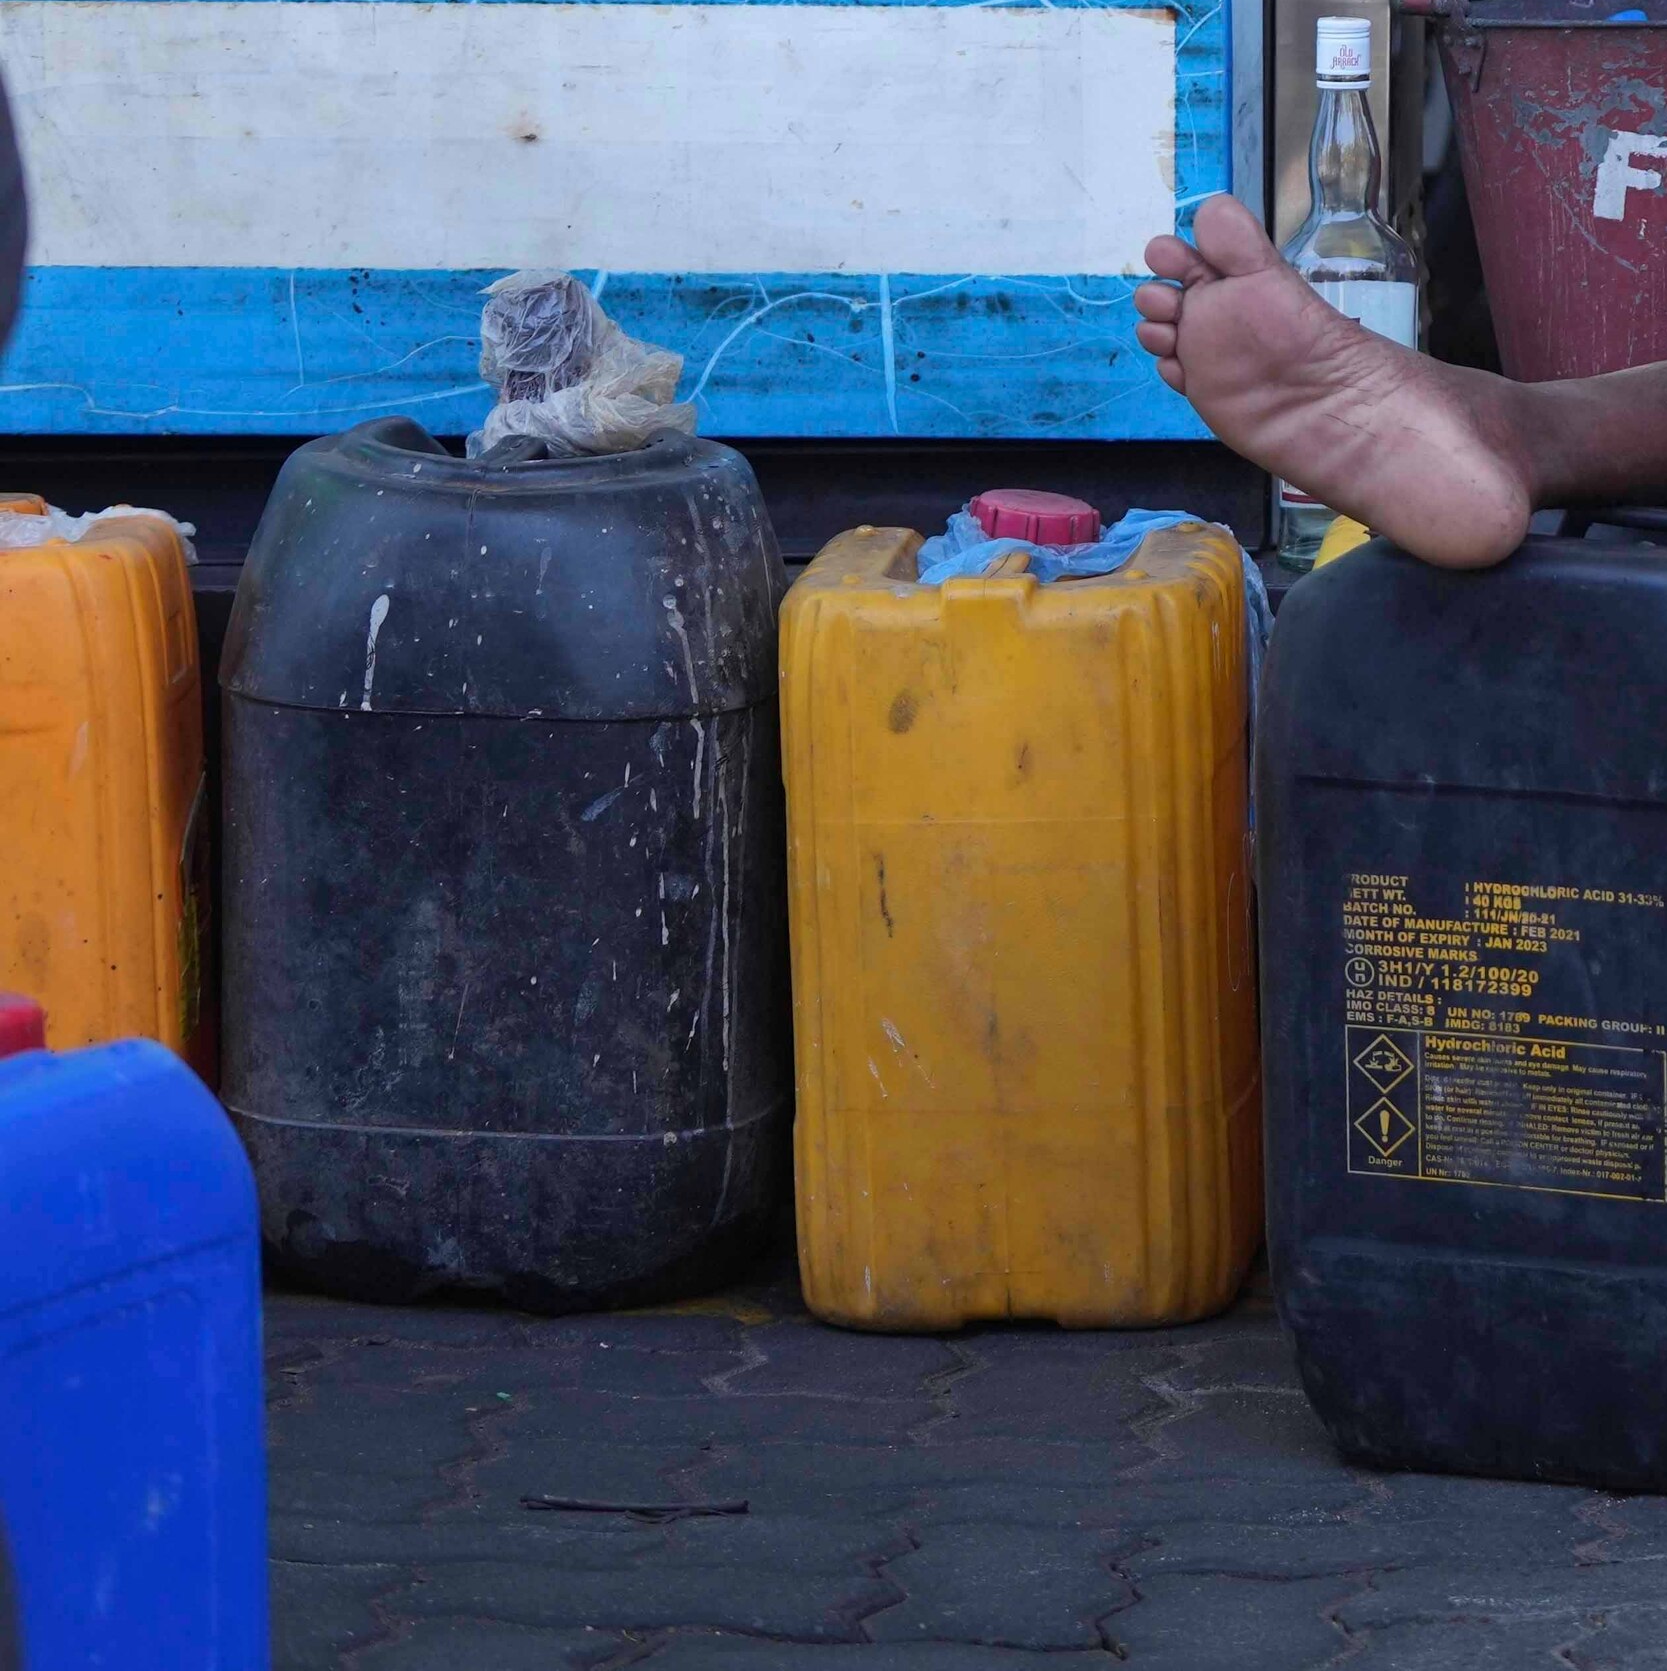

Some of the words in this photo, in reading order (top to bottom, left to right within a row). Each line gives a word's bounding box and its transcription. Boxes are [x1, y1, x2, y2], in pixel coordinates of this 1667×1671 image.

[1346, 873, 1409, 887] RODUCT
[1347, 887, 1379, 900] ETT
[1382, 888, 1407, 901] WT.
[1473, 881, 1580, 900] HYDROCHLORIC
[1583, 888, 1615, 902] ACID
[1343, 901, 1389, 914] BATCH
[1393, 903, 1417, 916] NO.
[1343, 914, 1379, 927] DATE
[1382, 917, 1401, 928] OF
[1404, 918, 1509, 935] MANUFACTURE
[1521, 926, 1546, 938] FEB
[1550, 928, 1581, 941] 2021
[1343, 928, 1394, 942] MONTH
[1398, 931, 1416, 943] OF
[1420, 933, 1470, 946] EXPIRY
[1485, 937, 1513, 949] JAN
[1516, 939, 1548, 952] 2023
[1345, 943, 1424, 958] CORROSIVE
[1428, 947, 1478, 962] MARKS
[1378, 960, 1436, 977] 3H1/Y
[1441, 965, 1539, 984] 1.2/100/20
[1378, 974, 1413, 988] IND
[1431, 978, 1532, 997] 118172399
[1345, 988, 1374, 1000] HAZ
[1378, 990, 1434, 1004] DETAILS
[1346, 1000, 1372, 1011] IMO
[1375, 1001, 1424, 1015] CLASS:
[1447, 1007, 1468, 1018] UN
[1471, 1009, 1496, 1020] NO:
[1538, 1013, 1598, 1029] PACKING
[1346, 1011, 1375, 1022] EMS
[1425, 1035, 1527, 1055] Hydrochloric
[1530, 1043, 1566, 1060] Acid
[1367, 1154, 1403, 1169] Danger
